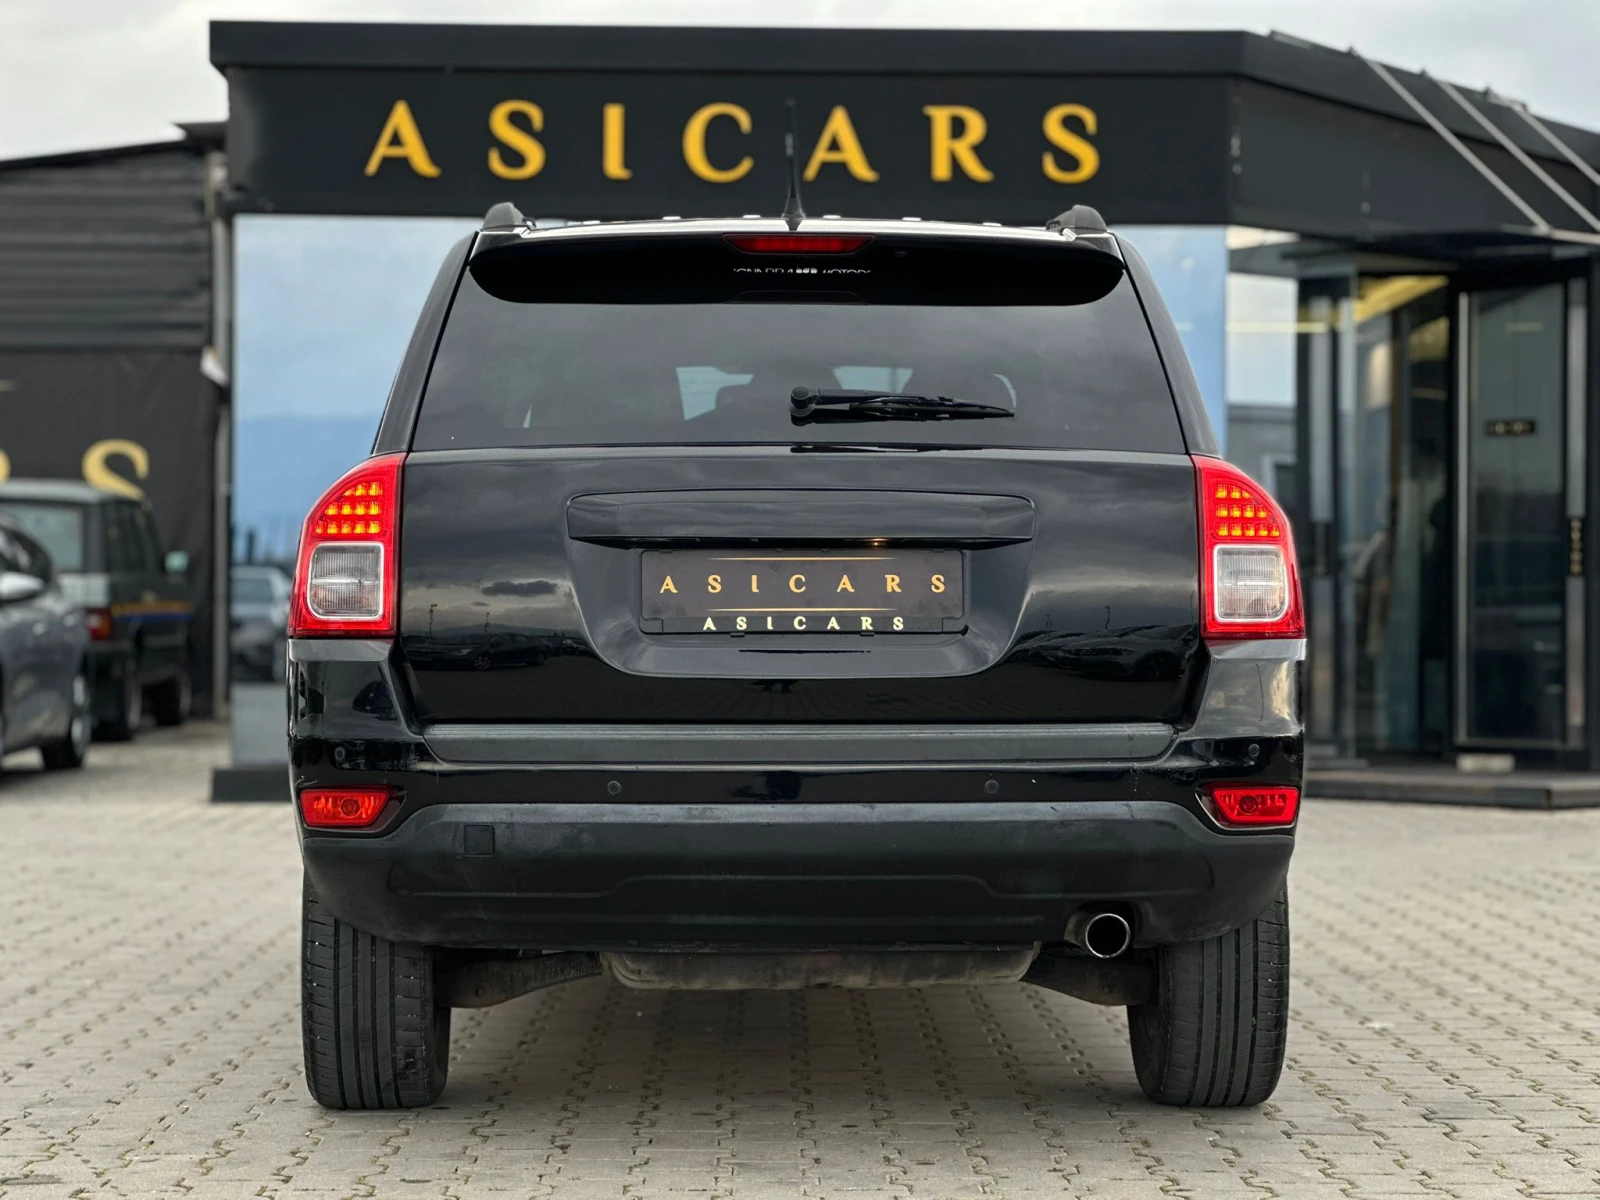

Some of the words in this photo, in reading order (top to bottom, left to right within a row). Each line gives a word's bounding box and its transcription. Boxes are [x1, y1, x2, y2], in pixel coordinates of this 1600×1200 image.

[366, 100, 1100, 184] ASICARS
[660, 573, 947, 594] ASICARS
[702, 615, 904, 631] ASICARS
